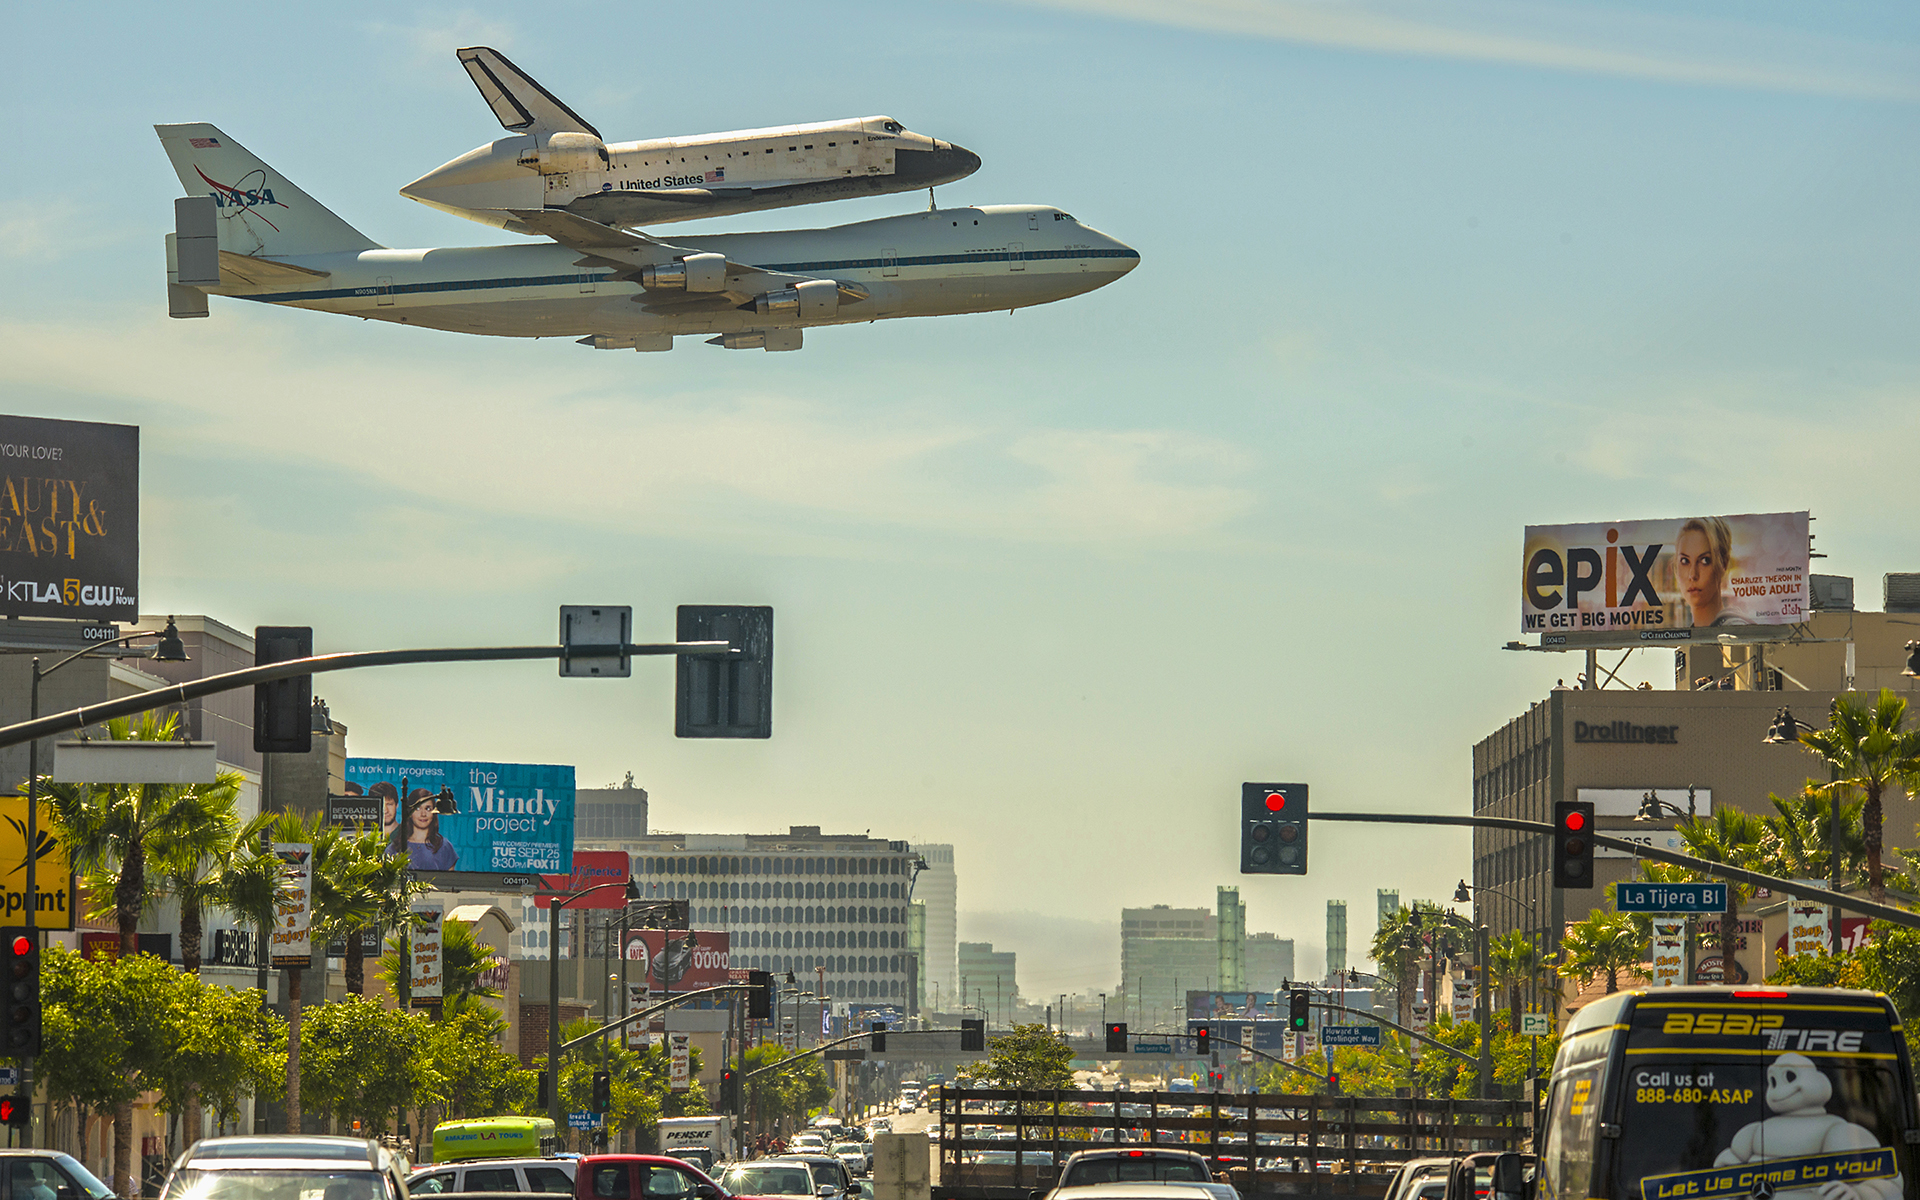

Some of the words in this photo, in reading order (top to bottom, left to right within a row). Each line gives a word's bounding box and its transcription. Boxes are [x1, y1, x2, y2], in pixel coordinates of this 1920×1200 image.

[620, 178, 661, 190] United
[663, 175, 704, 187] States
[209, 188, 278, 208] NASA
[0, 443, 30, 458] YOUR
[32, 446, 63, 461] LOVE?
[83, 499, 108, 537] &
[1731, 576, 1763, 585] CHARLIZE
[1765, 574, 1792, 583] THERON
[8, 581, 62, 604] KTLA
[64, 579, 80, 606] 5
[115, 587, 124, 596] TV
[1733, 585, 1766, 598] YOUNG
[1769, 583, 1801, 595] ADULT
[115, 596, 136, 606] NOW
[1781, 603, 1801, 615] dish
[1525, 614, 1546, 628] WE
[1550, 613, 1577, 627] GET
[1582, 612, 1605, 626] BIG
[1610, 610, 1664, 625] MOVIES
[83, 628, 115, 640] 004111
[1574, 721, 1679, 744] Drollinger
[358, 765, 383, 774] work
[386, 765, 396, 774] in
[398, 767, 446, 777] progress.
[469, 768, 497, 786] the
[468, 786, 561, 826] Mindy
[476, 815, 536, 834] project
[493, 847, 517, 857] TUE
[518, 848, 546, 858] SEPT
[547, 849, 560, 859] 25
[527, 859, 548, 869] FOX
[550, 860, 560, 870] 11
[1625, 889, 1645, 904] La
[1648, 889, 1696, 909] Tijera
[1702, 889, 1719, 905] Bl
[287, 916, 296, 928] &
[273, 927, 310, 945] Enjoy!
[1791, 925, 1825, 939] Shop,
[414, 942, 440, 954] Shop,
[416, 955, 438, 965] Dine
[1656, 955, 1682, 967] Shop,
[423, 965, 431, 974] &
[1657, 968, 1680, 979] Dine
[412, 973, 442, 988] Enjoy!
[1325, 1028, 1352, 1036] Howard
[1325, 1035, 1360, 1044] Drollinger
[1361, 1036, 1376, 1044] Way
[1761, 1028, 1864, 1052] TIRE
[1636, 1072, 1670, 1087] Call
[1674, 1075, 1693, 1087] us
[1697, 1073, 1715, 1087] at
[1636, 1088, 1753, 1104] 888-680-ASAP
[445, 1134, 478, 1142] AMAZING
[480, 1132, 497, 1141] LA
[666, 1131, 713, 1140] PENSKE
[1658, 1181, 1699, 1198] Let
[1705, 1177, 1734, 1191] Us
[1802, 1163, 1829, 1179] to
[1835, 1157, 1882, 1176] You!
